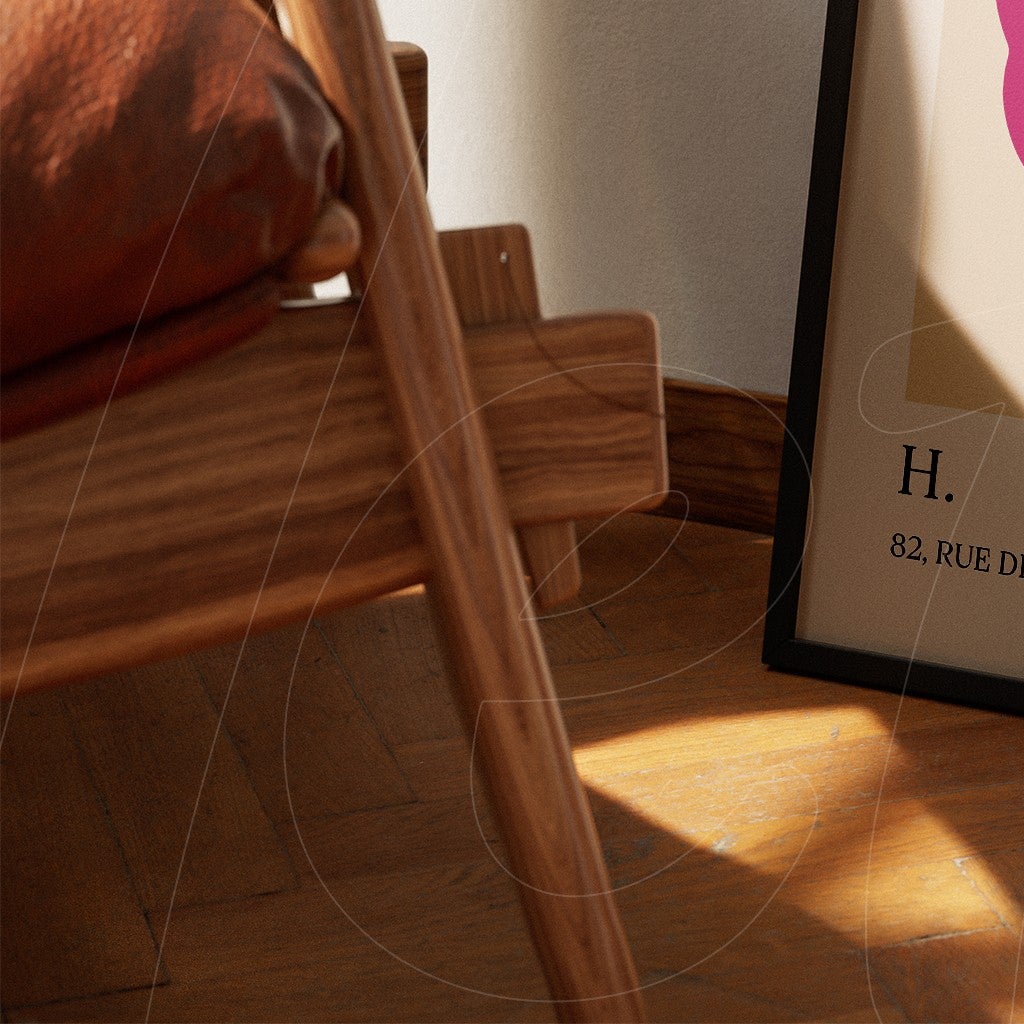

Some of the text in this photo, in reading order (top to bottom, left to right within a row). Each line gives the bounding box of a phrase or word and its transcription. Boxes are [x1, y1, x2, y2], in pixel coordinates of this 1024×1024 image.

[897, 444, 955, 503] H.
[889, 532, 928, 567] 82,
[935, 539, 991, 573] RUE
